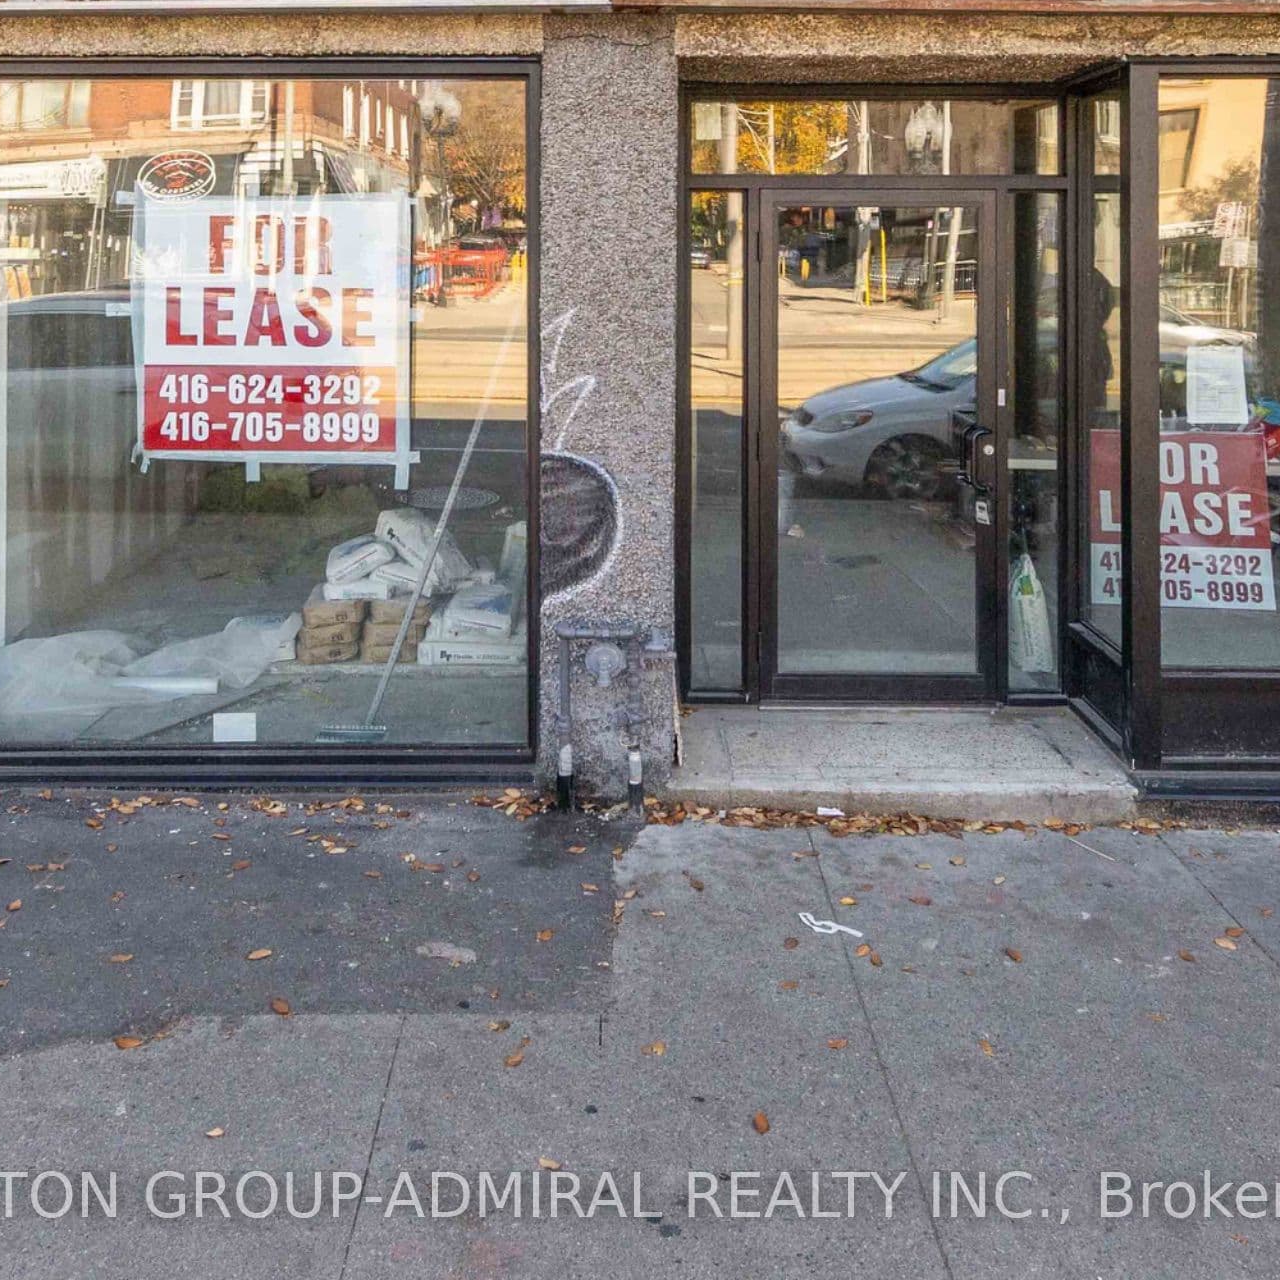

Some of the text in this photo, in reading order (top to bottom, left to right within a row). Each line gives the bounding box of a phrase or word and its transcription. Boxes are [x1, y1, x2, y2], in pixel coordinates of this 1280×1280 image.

[209, 215, 333, 276] FOR
[165, 287, 376, 347] LEASE
[159, 374, 381, 405] 416-624-3292
[160, 412, 380, 443] 416-705-8999
[1159, 441, 1220, 485] OR
[1100, 489, 1255, 536] LASE
